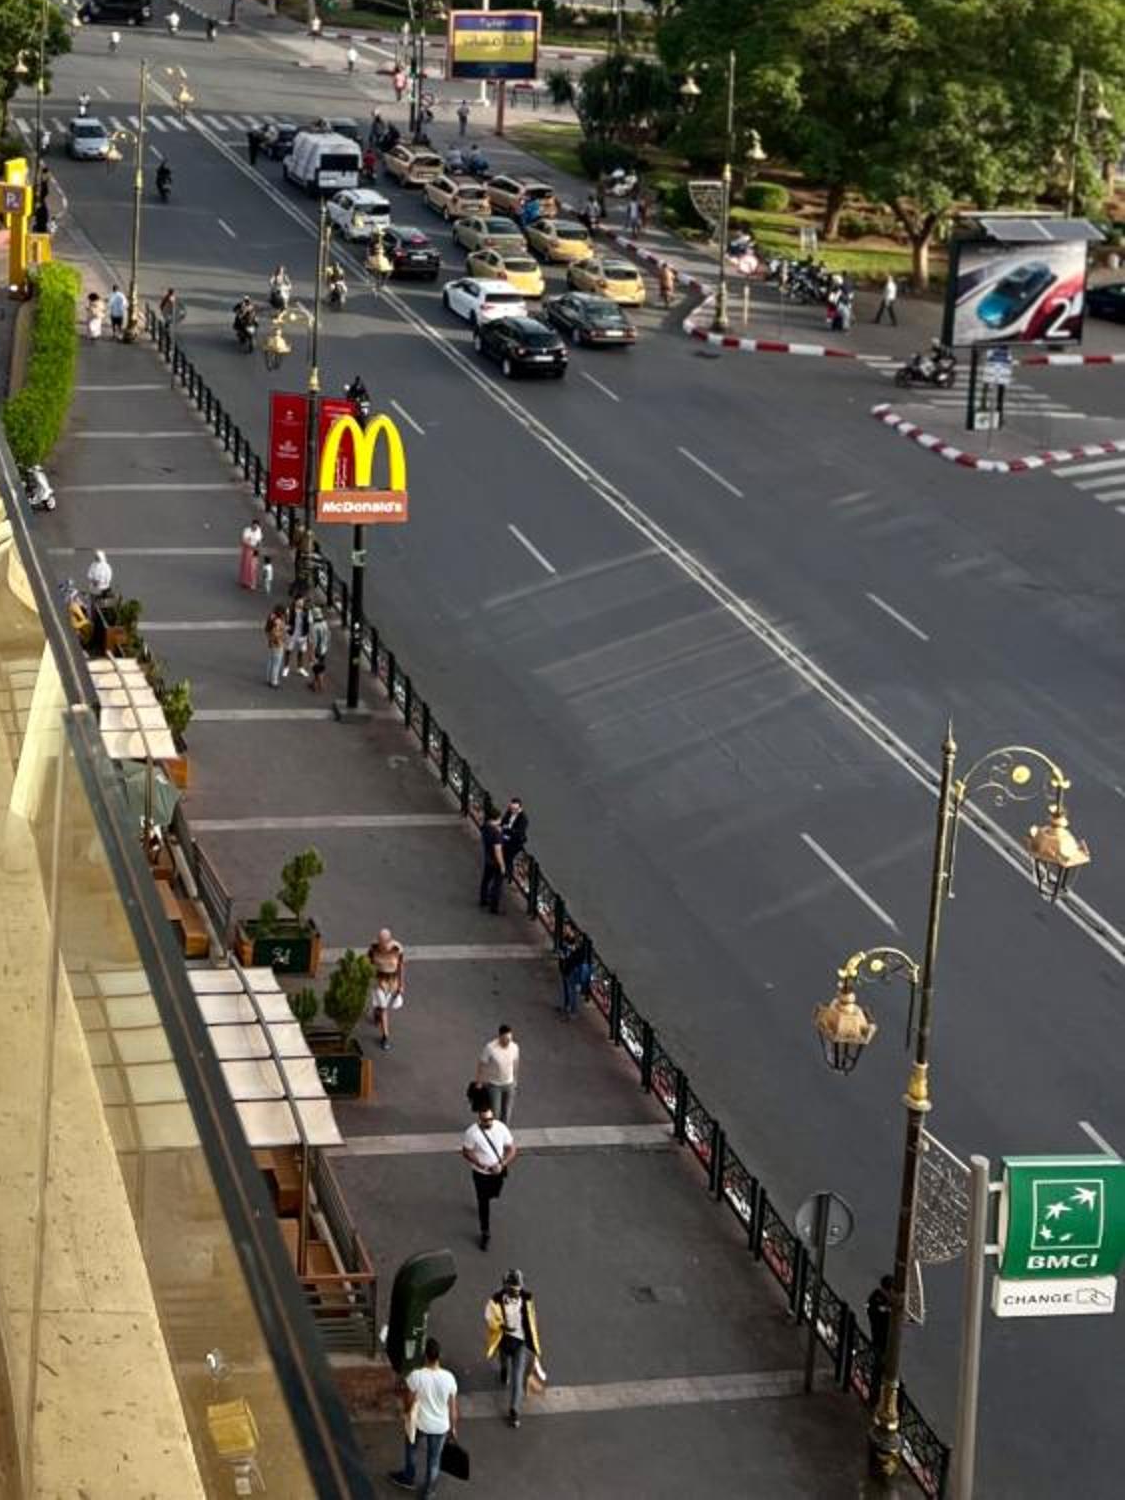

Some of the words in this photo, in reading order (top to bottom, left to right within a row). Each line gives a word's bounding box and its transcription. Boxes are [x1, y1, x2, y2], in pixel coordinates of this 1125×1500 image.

[1046, 297, 1071, 337] 2
[322, 501, 402, 513] McDonald's
[1027, 1254, 1098, 1269] BMCI
[1003, 1294, 1073, 1305] CHANGE
